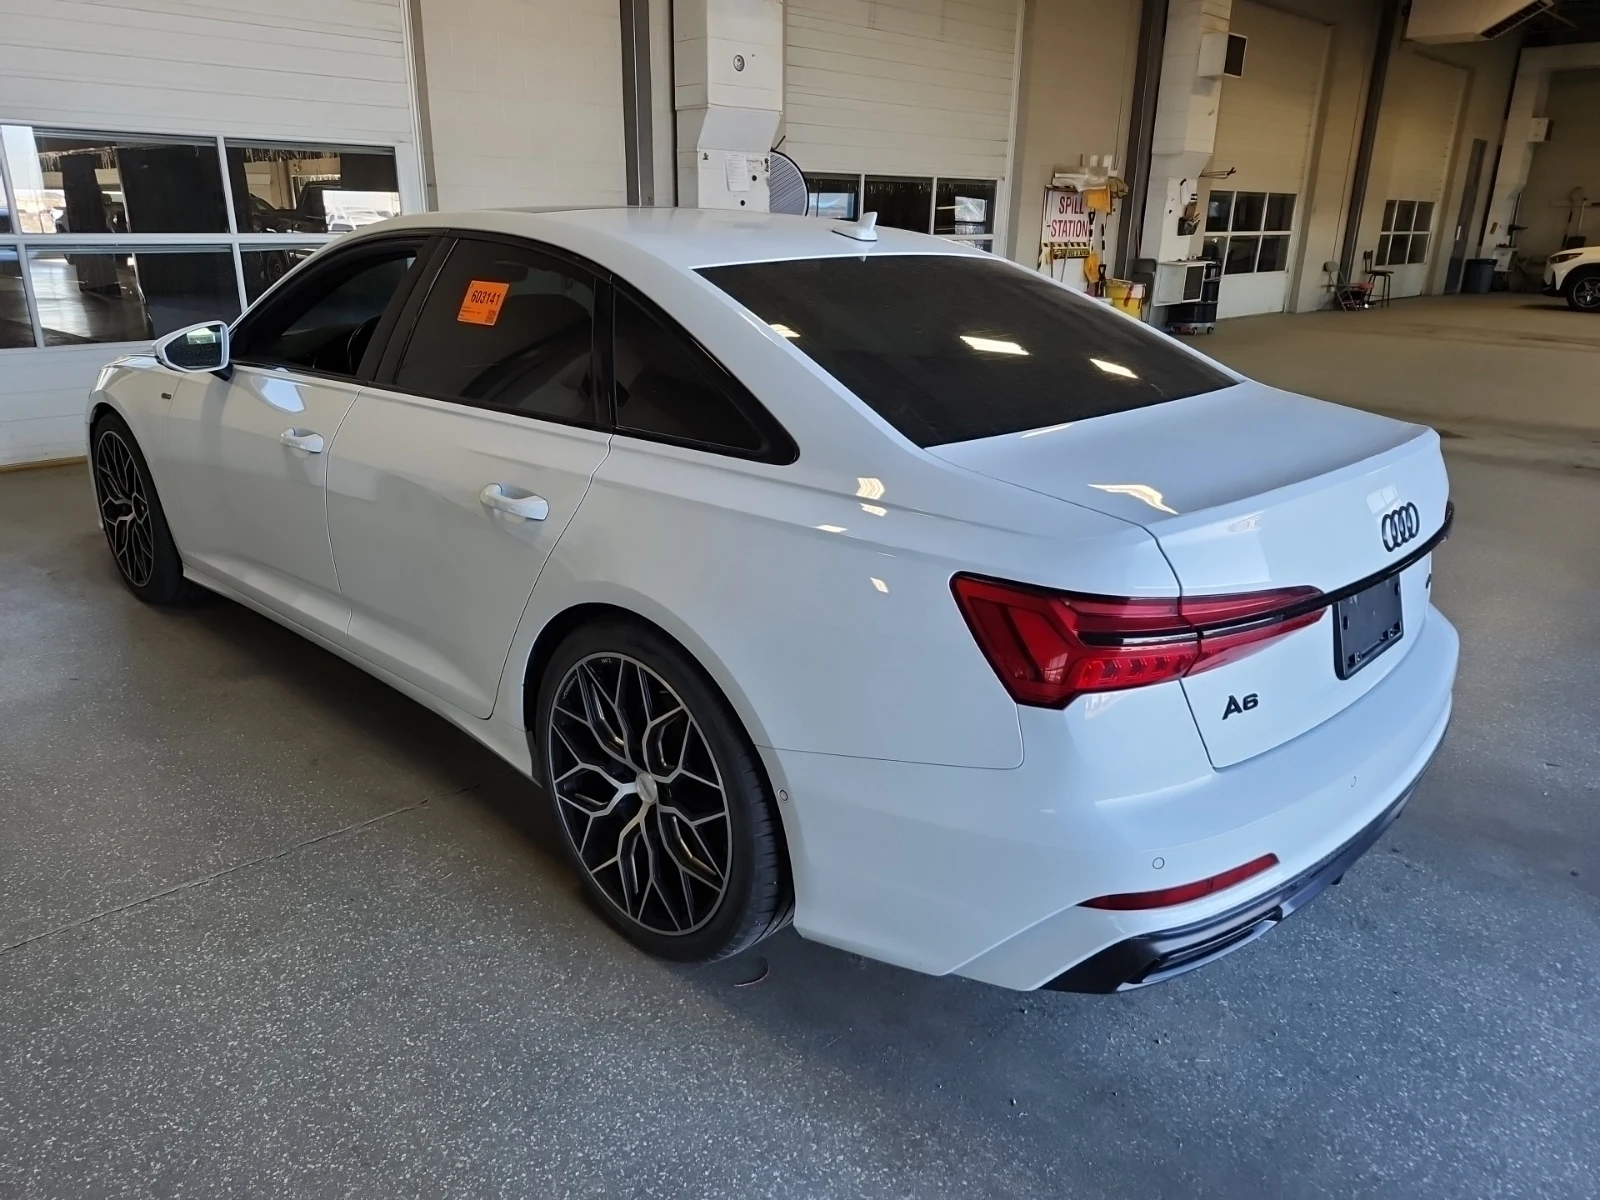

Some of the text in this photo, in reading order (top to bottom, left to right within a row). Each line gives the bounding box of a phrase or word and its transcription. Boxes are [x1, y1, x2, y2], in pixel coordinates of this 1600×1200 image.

[1059, 196, 1084, 214] SPILL
[1051, 220, 1088, 237] STATION
[471, 290, 501, 305] 603141
[1222, 693, 1258, 720] A6
